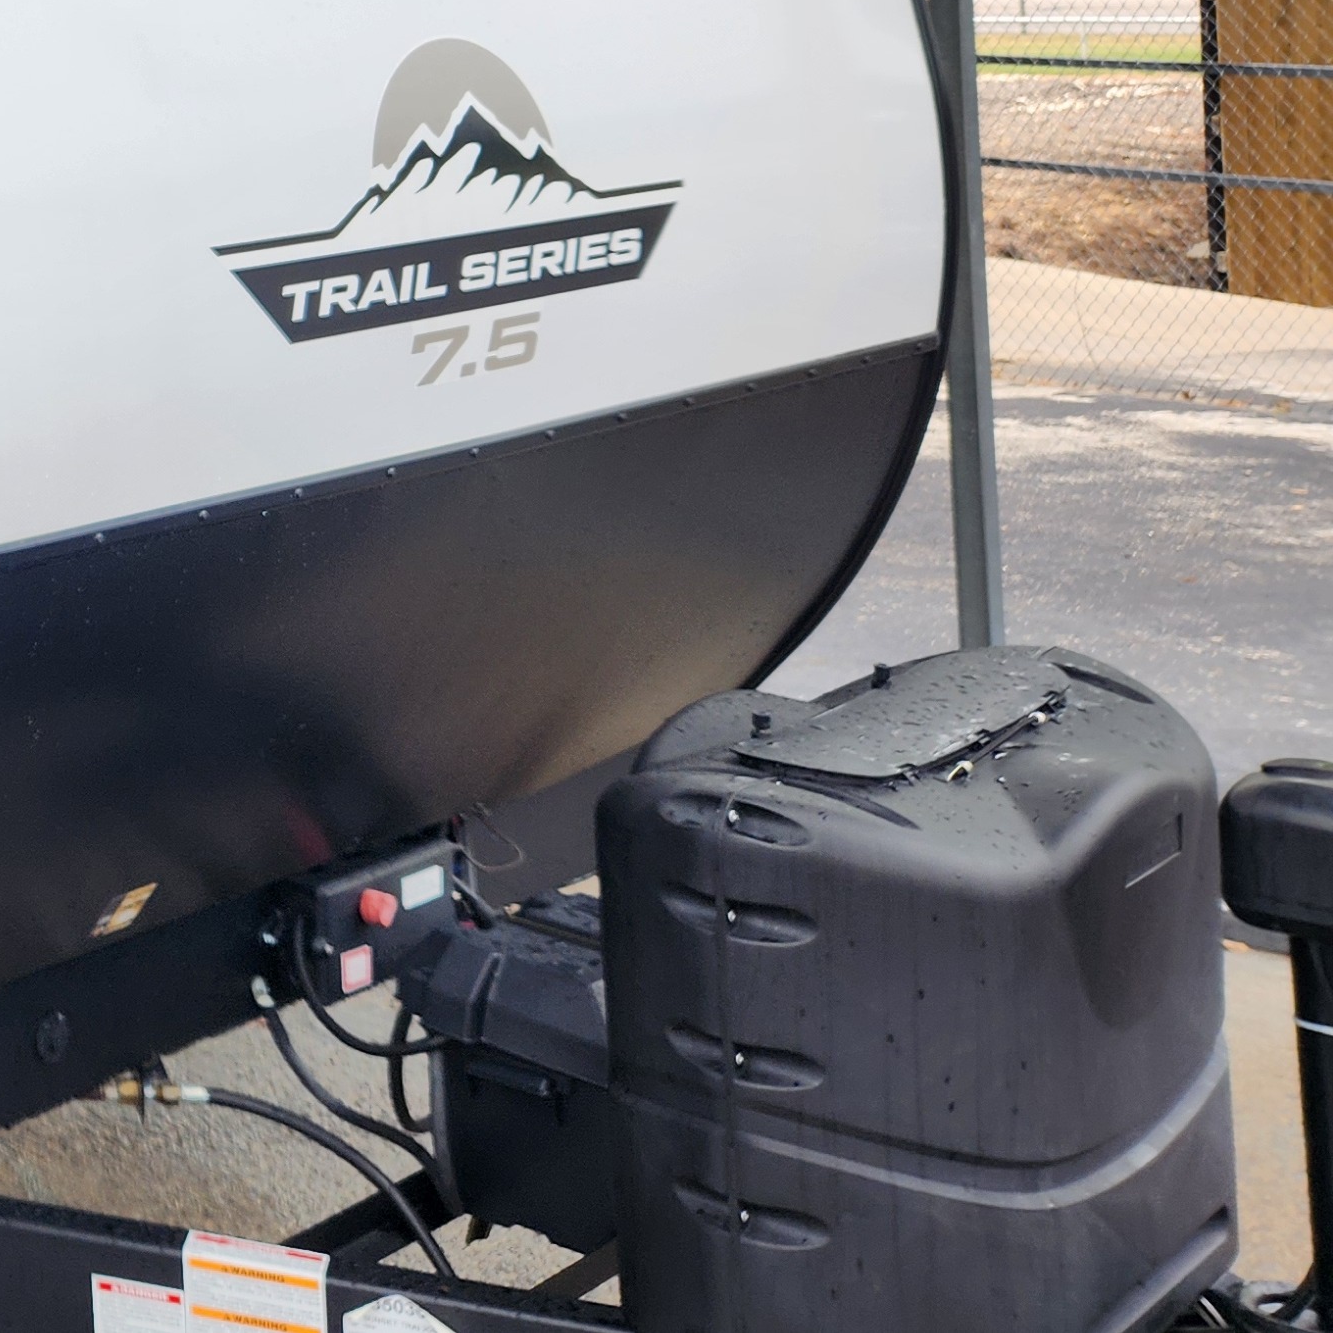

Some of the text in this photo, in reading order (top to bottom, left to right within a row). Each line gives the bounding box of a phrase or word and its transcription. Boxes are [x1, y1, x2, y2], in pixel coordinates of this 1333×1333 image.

[281, 227, 644, 323] TRAIL SERIES
[411, 311, 541, 387] 7.5
[230, 1265, 285, 1283] WARNING
[232, 1313, 288, 1332] WARNING
